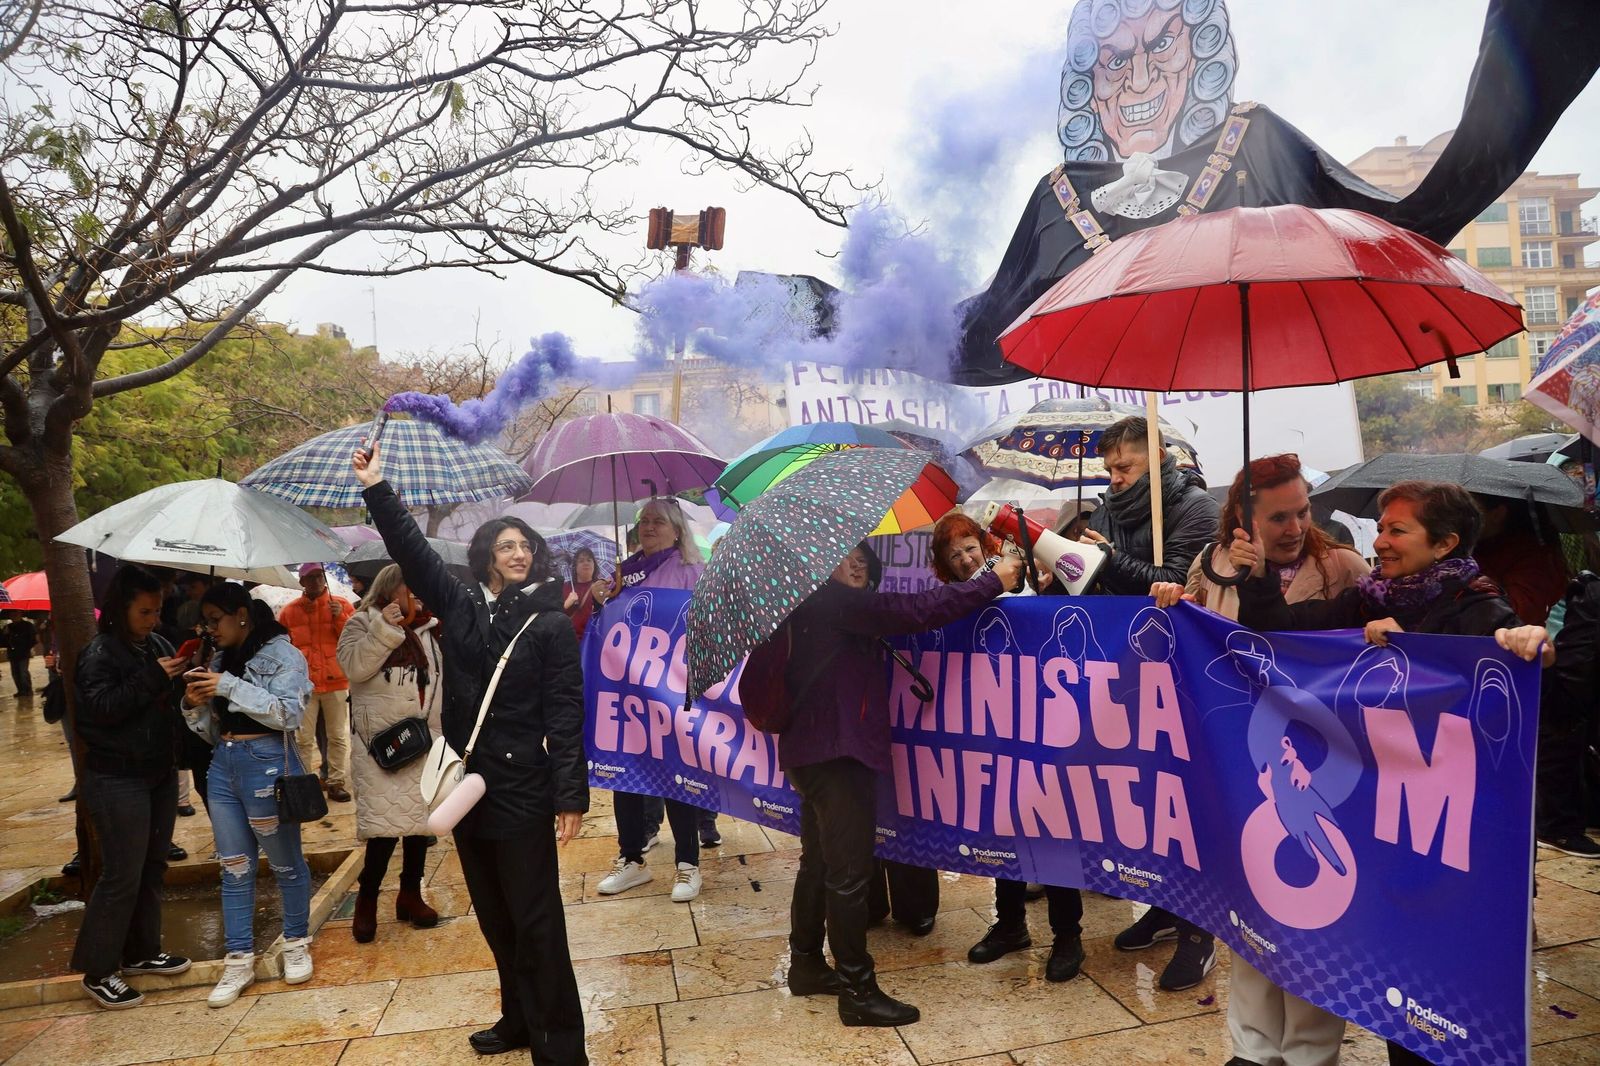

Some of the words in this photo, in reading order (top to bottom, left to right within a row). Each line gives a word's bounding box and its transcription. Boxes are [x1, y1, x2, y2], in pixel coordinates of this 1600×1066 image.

[889, 650, 1191, 762] MINISTA
[595, 762, 626, 773] Podemos
[762, 800, 793, 814] Podemos
[891, 742, 1200, 871] INFINITA
[972, 847, 1017, 859] Podemos
[1117, 863, 1163, 883] Podemos
[1119, 872, 1150, 888] Málaga
[1240, 919, 1277, 953] Podemos
[1406, 997, 1468, 1040] Podemos
[1406, 1011, 1446, 1042] Málaga
